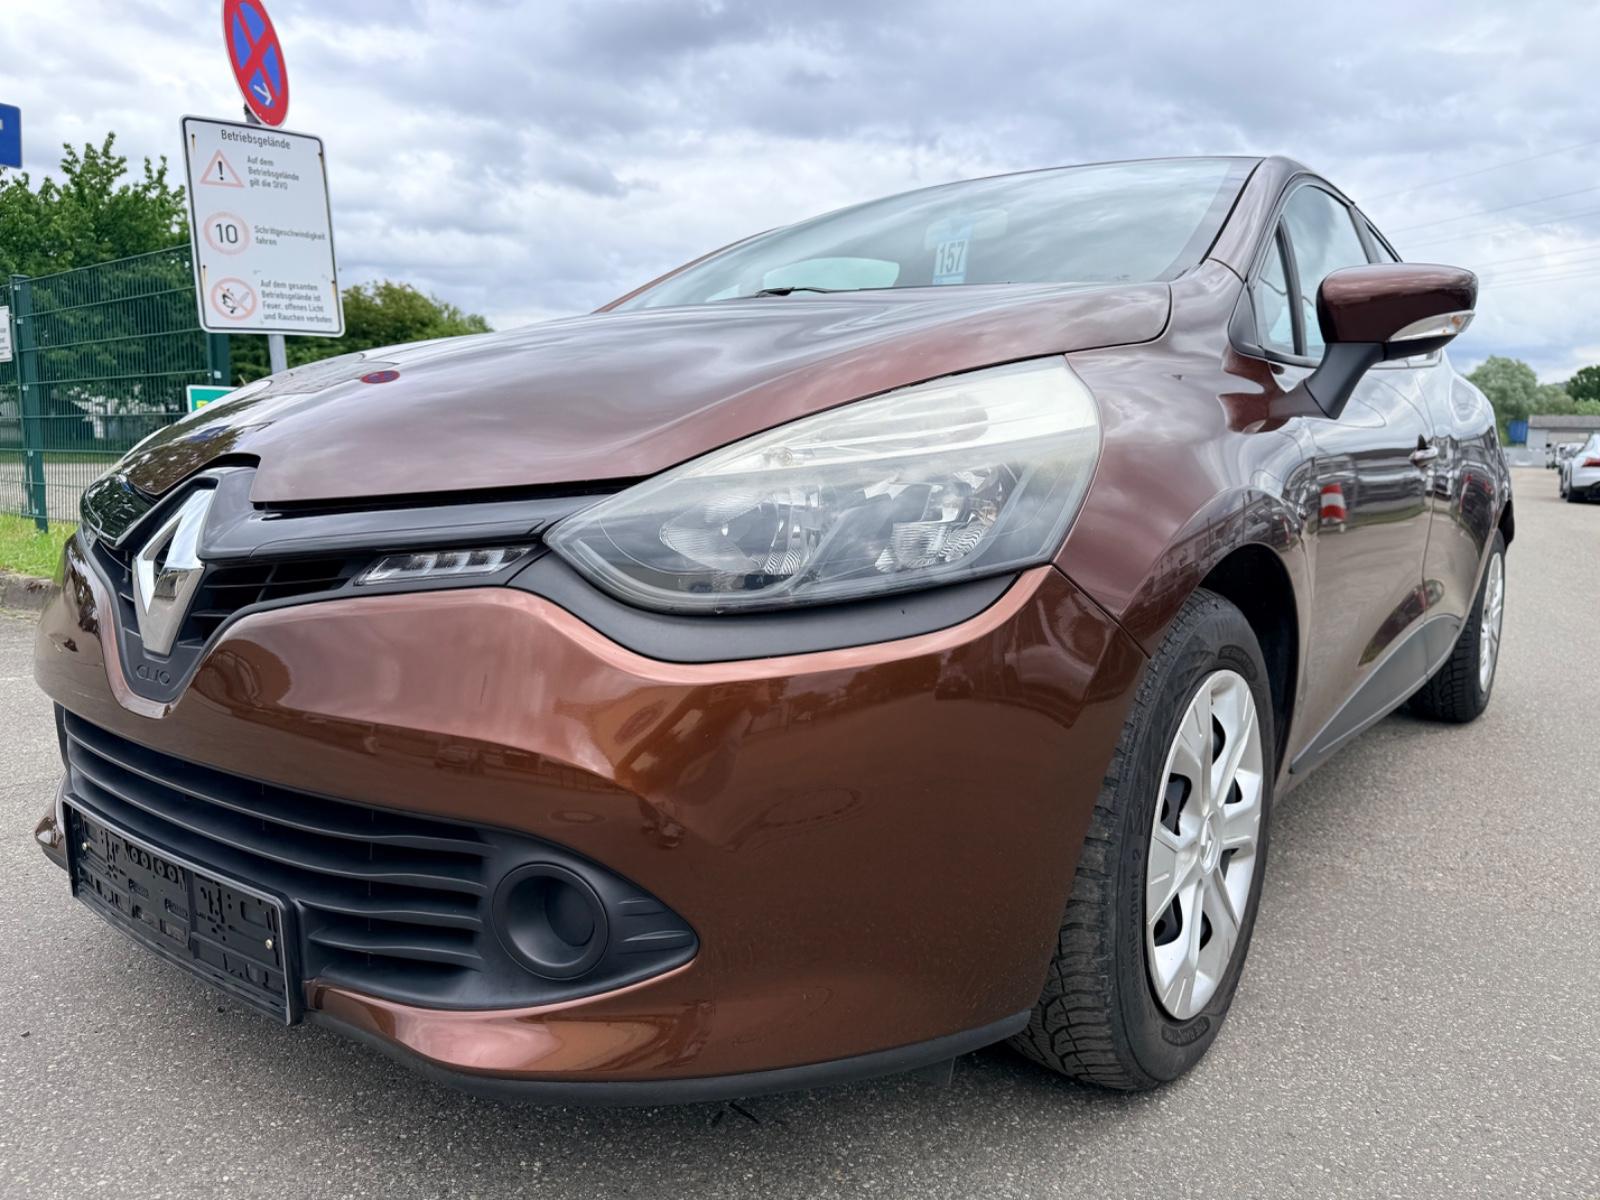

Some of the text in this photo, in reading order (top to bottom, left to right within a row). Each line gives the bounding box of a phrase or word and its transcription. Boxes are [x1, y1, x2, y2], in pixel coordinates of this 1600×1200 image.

[221, 129, 291, 150] Betriebsgelände
[247, 155, 274, 167] Auf dem
[248, 167, 300, 181] Betriebsgelände
[215, 223, 238, 244] 10
[254, 225, 326, 241] Schrittgeschwindigkeit
[256, 236, 277, 246] fahren
[939, 240, 965, 274] 157
[260, 279, 272, 288] Auf
[273, 280, 287, 289] dem
[261, 290, 313, 303] Betriebsgelände
[284, 302, 308, 312] offenes
[309, 304, 324, 313] Licht
[264, 311, 333, 324] und Rauchen verboten
[136, 664, 171, 686] CLIO
